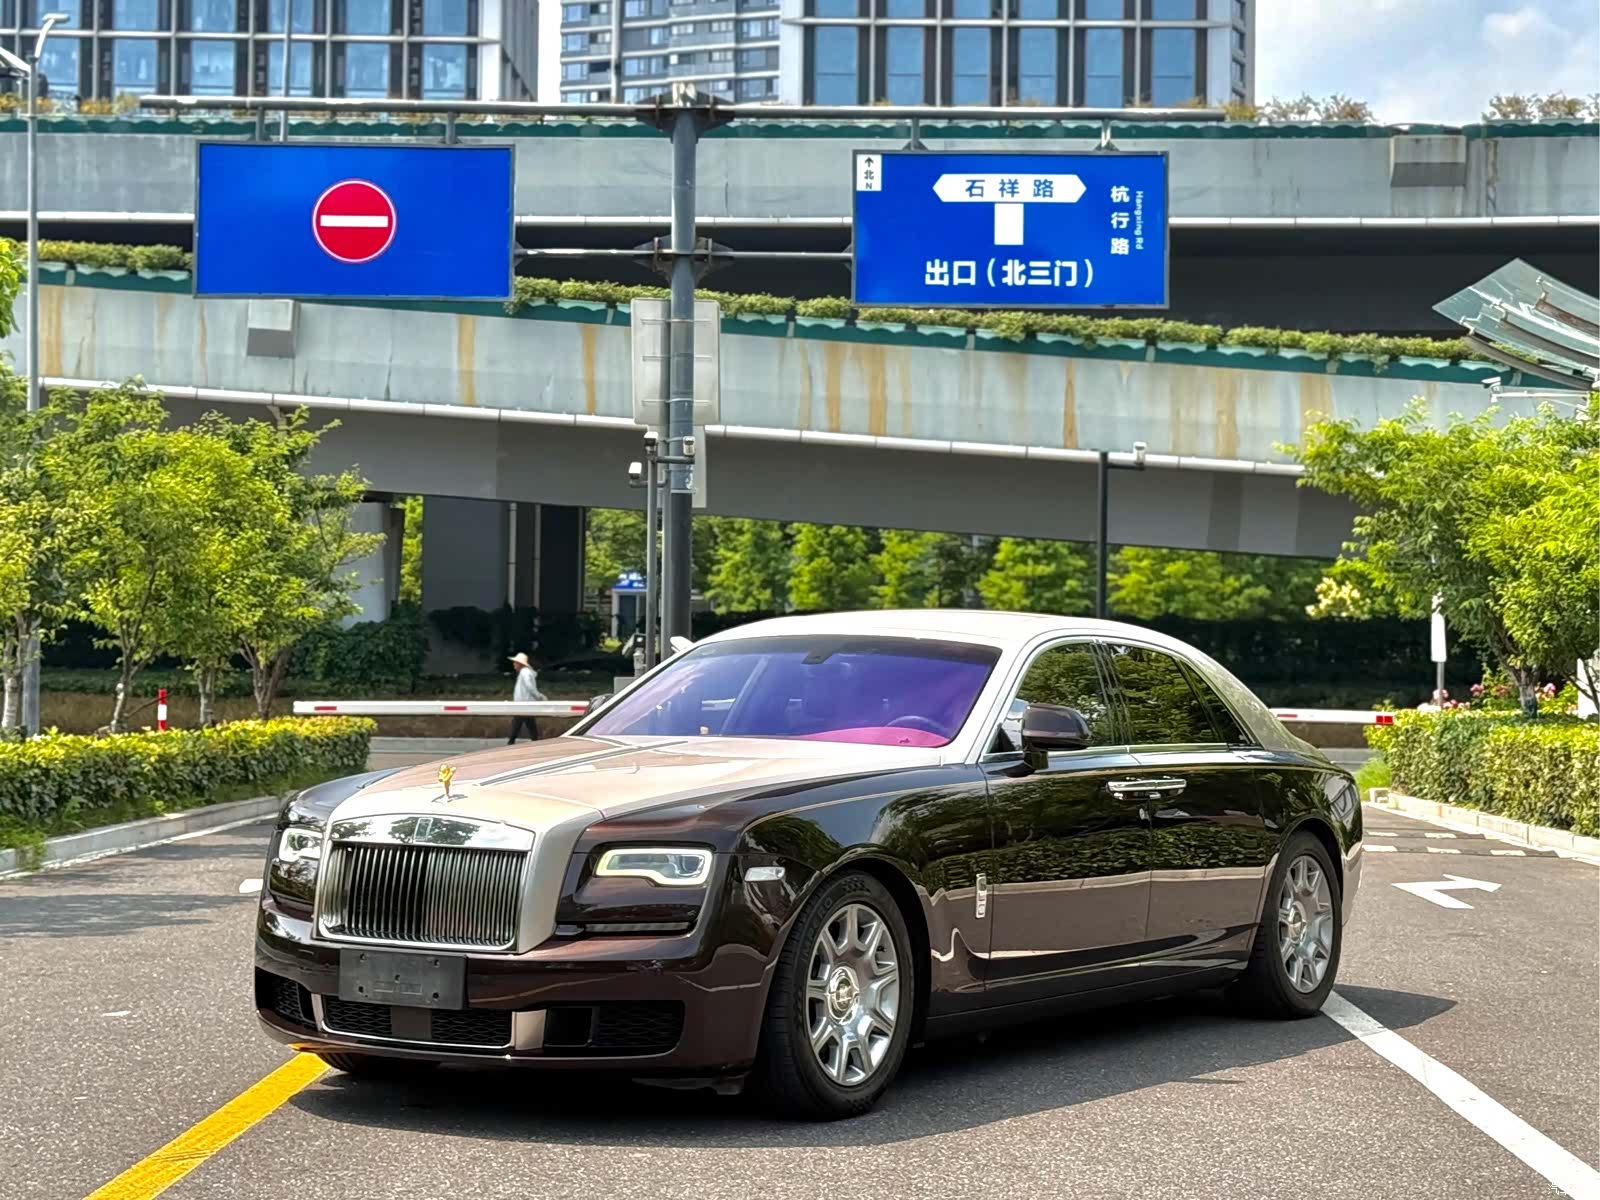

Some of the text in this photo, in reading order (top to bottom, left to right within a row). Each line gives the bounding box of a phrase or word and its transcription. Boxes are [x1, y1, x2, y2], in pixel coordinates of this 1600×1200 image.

[864, 169, 874, 180] 北
[865, 182, 873, 190] N
[965, 178, 1054, 198] 石祥路
[1111, 186, 1130, 255] 杭行路
[1133, 190, 1144, 250] Hangxing Rd
[924, 257, 1093, 288] 出口（北三门）
